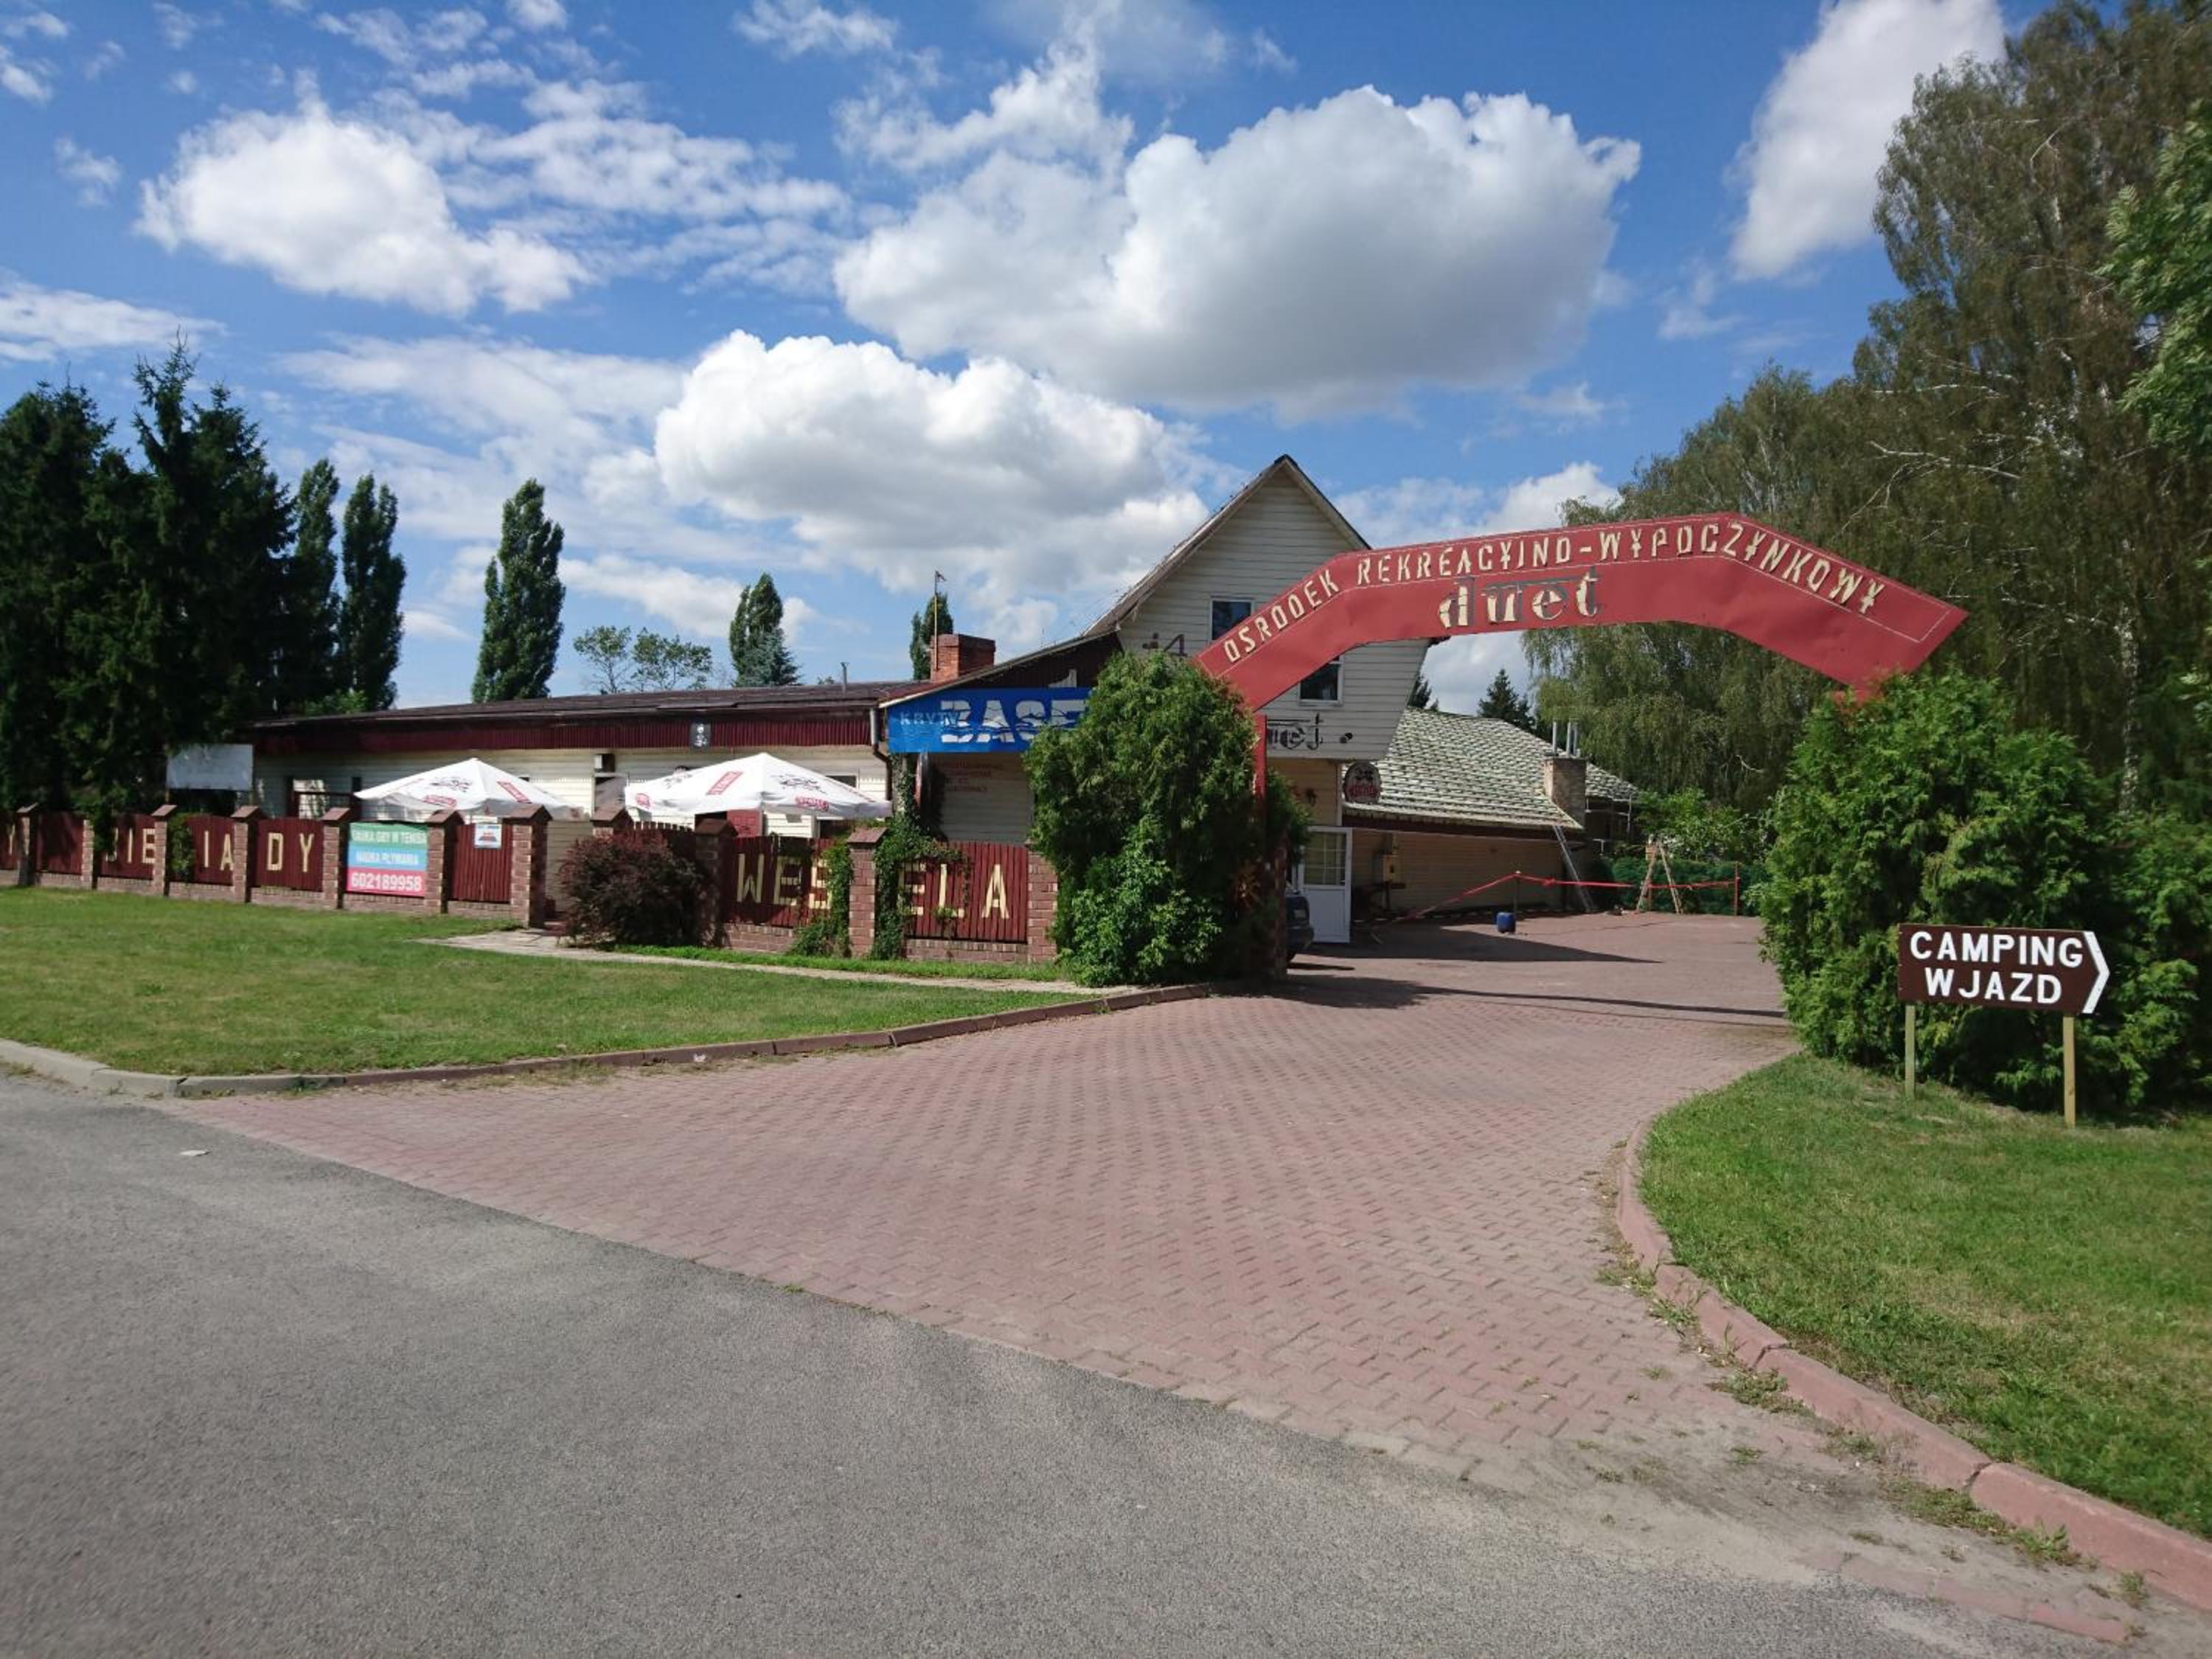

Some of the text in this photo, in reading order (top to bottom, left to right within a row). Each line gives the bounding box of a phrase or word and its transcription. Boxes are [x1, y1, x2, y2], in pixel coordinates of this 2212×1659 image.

[1439, 568, 1600, 628] duet
[941, 699, 1087, 743] BASE
[352, 872, 422, 892] 602189958
[1910, 931, 2084, 968] CAMPING
[1924, 967, 2062, 1004] WJAZD
